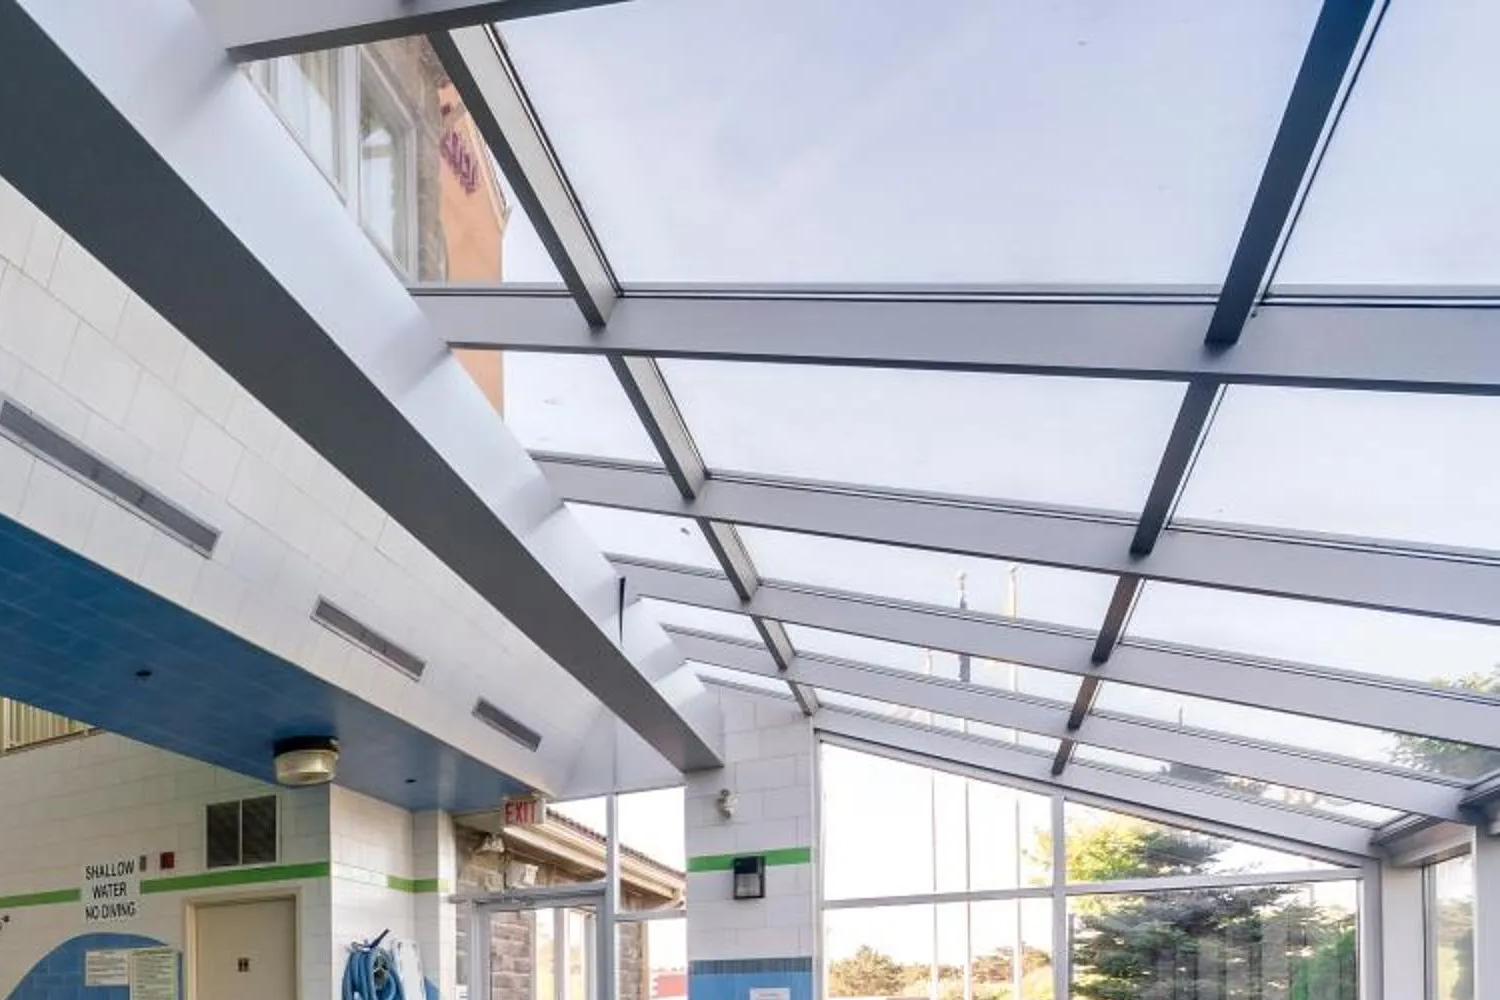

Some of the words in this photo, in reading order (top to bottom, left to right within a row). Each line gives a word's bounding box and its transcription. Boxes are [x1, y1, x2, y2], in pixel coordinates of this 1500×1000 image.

[505, 800, 537, 824] EXIT
[85, 860, 135, 880] SHALLOW
[92, 882, 127, 899] WATER
[85, 904, 99, 920] NO
[102, 902, 136, 919] DIVING
